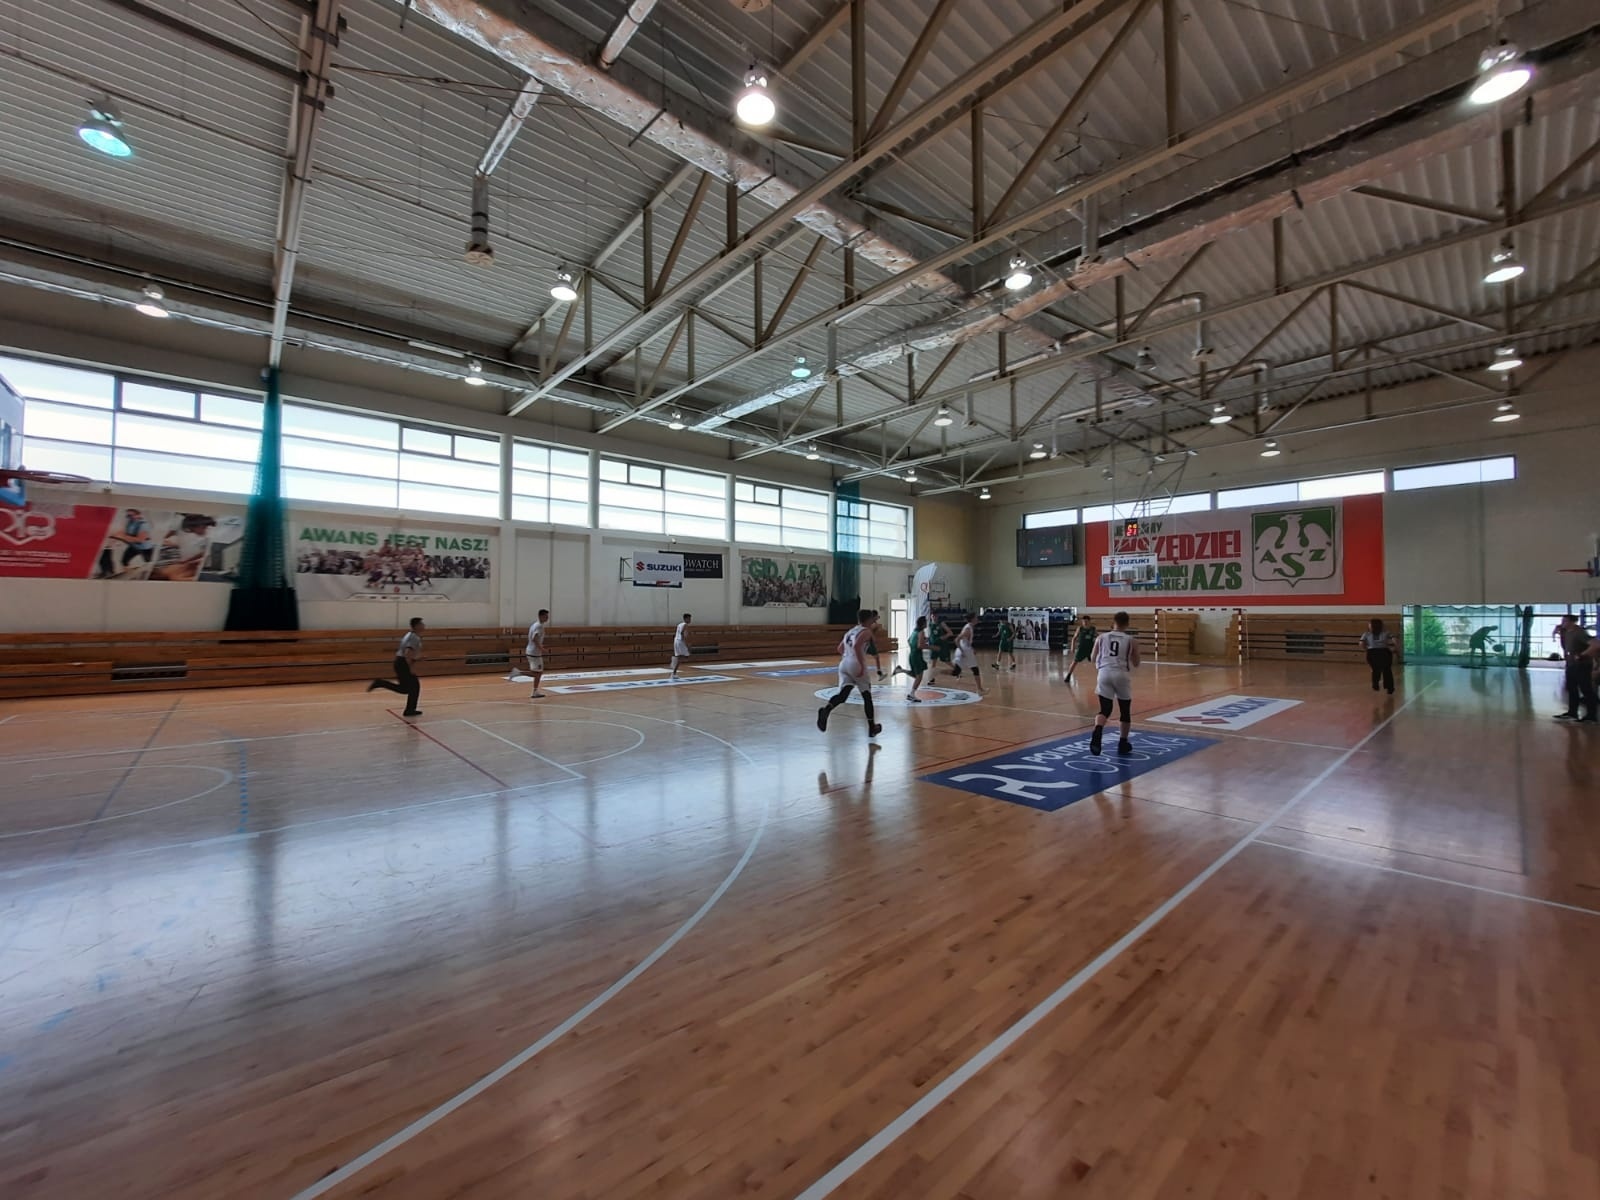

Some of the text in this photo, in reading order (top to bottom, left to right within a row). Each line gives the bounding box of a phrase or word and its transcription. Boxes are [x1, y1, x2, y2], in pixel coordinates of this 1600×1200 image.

[299, 527, 378, 546] AWANS
[435, 536, 489, 552] NASZ!
[646, 563, 682, 572] SUZUKI
[1190, 561, 1242, 591] AZS
[1109, 640, 1120, 657] 9
